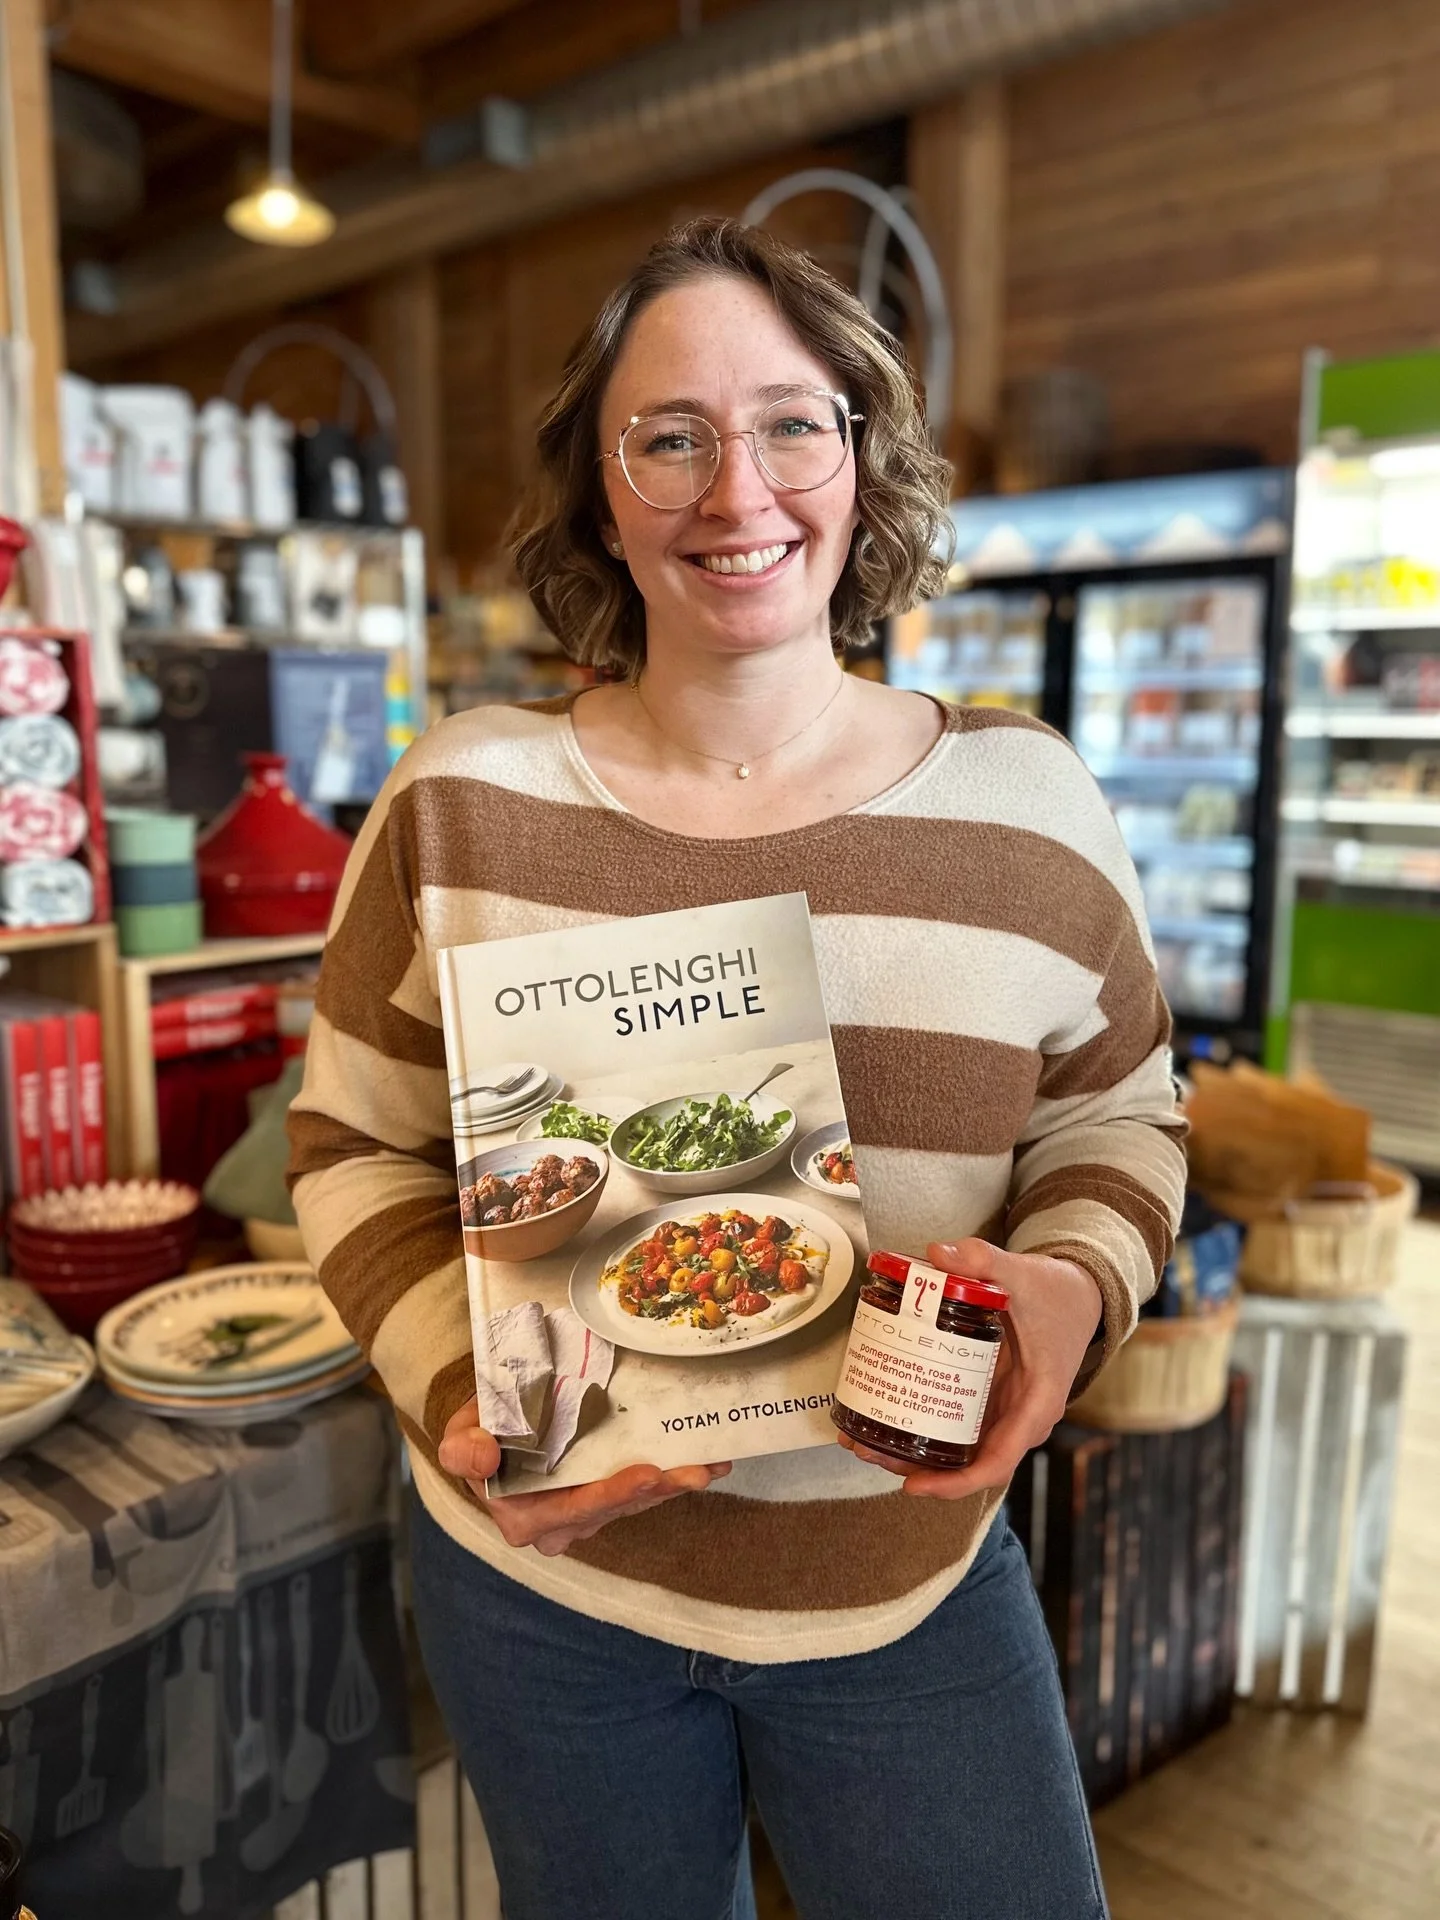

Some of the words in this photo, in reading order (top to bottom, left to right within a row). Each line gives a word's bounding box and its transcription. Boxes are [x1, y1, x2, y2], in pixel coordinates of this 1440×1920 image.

[495, 947, 757, 1016] OTTOLENGHI
[614, 985, 765, 1036] SIMPLE
[856, 1310, 990, 1361] OTTOLENGHI
[860, 1343, 926, 1376] pomegranate,
[928, 1367, 951, 1382] rose
[953, 1373, 961, 1383] &
[880, 1361, 912, 1382] lemon
[914, 1374, 952, 1393] harissa
[954, 1385, 977, 1398] paste
[855, 1380, 874, 1394] rose
[875, 1389, 887, 1399] et
[887, 1395, 901, 1406] au
[903, 1396, 935, 1416] citron
[937, 1408, 965, 1422] confit
[864, 1371, 898, 1392] harissa
[900, 1385, 907, 1396] à
[909, 1387, 918, 1398] la
[921, 1394, 964, 1412] grenade,
[661, 1411, 720, 1433] YOTAM
[728, 1392, 836, 1422] OTTOLENGHI
[870, 1407, 883, 1420] 175
[884, 1413, 898, 1426] mL
